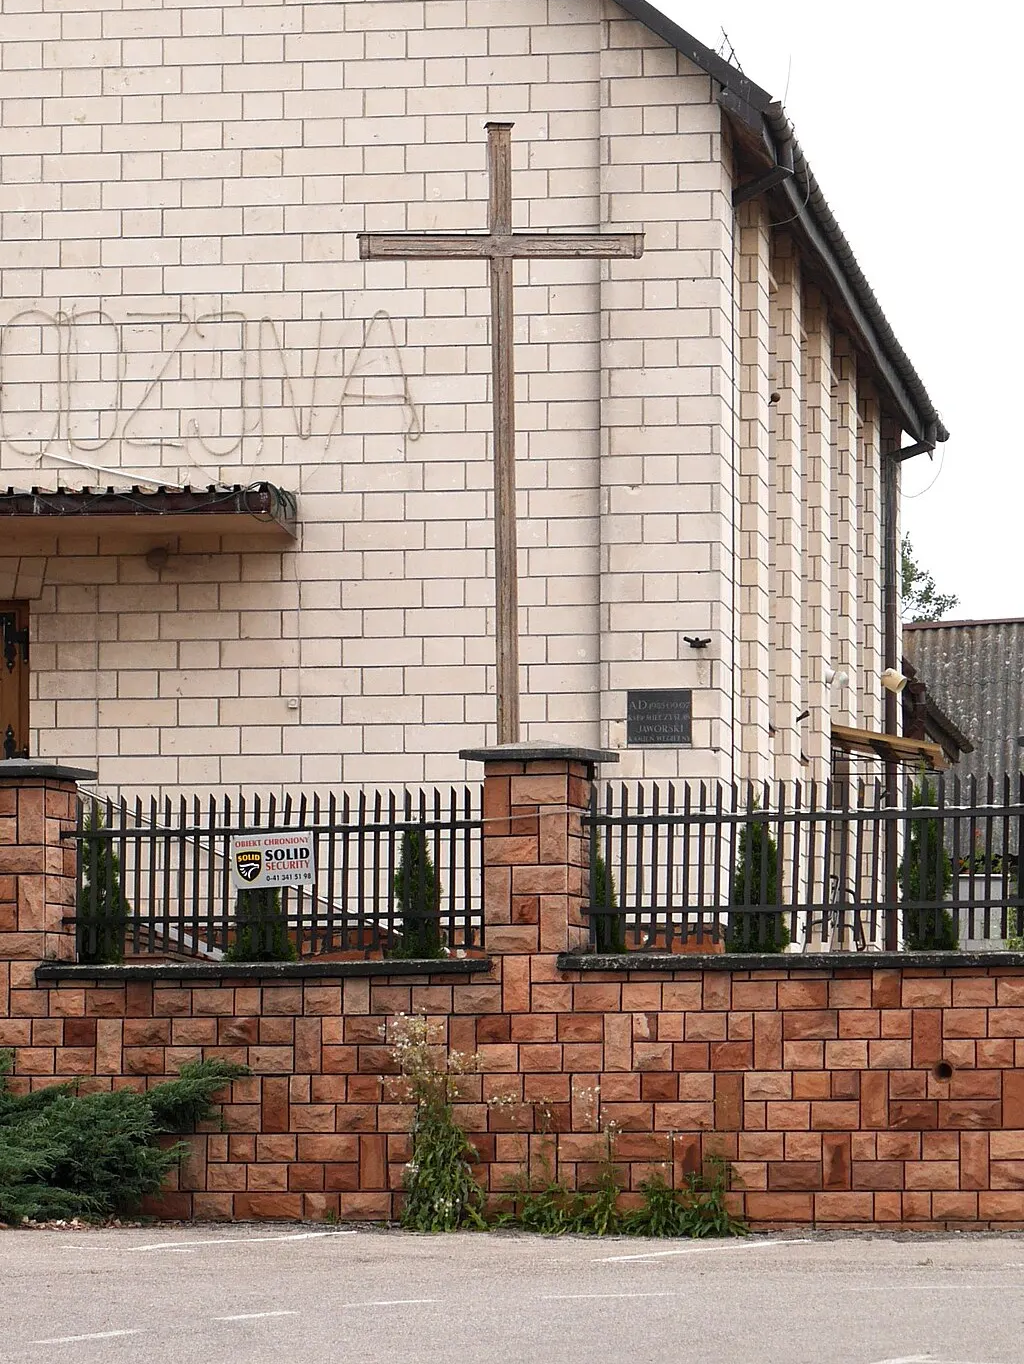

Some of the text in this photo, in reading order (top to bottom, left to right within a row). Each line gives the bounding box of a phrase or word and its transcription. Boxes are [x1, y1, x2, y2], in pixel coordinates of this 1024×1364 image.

[636, 724, 684, 733] JAWORSKI
[235, 837, 309, 848] OBIEKT CHRONIONY
[237, 854, 261, 862] SOLID
[265, 847, 310, 861] SOLID
[265, 860, 310, 871] SECURITY
[303, 872, 312, 880] 98
